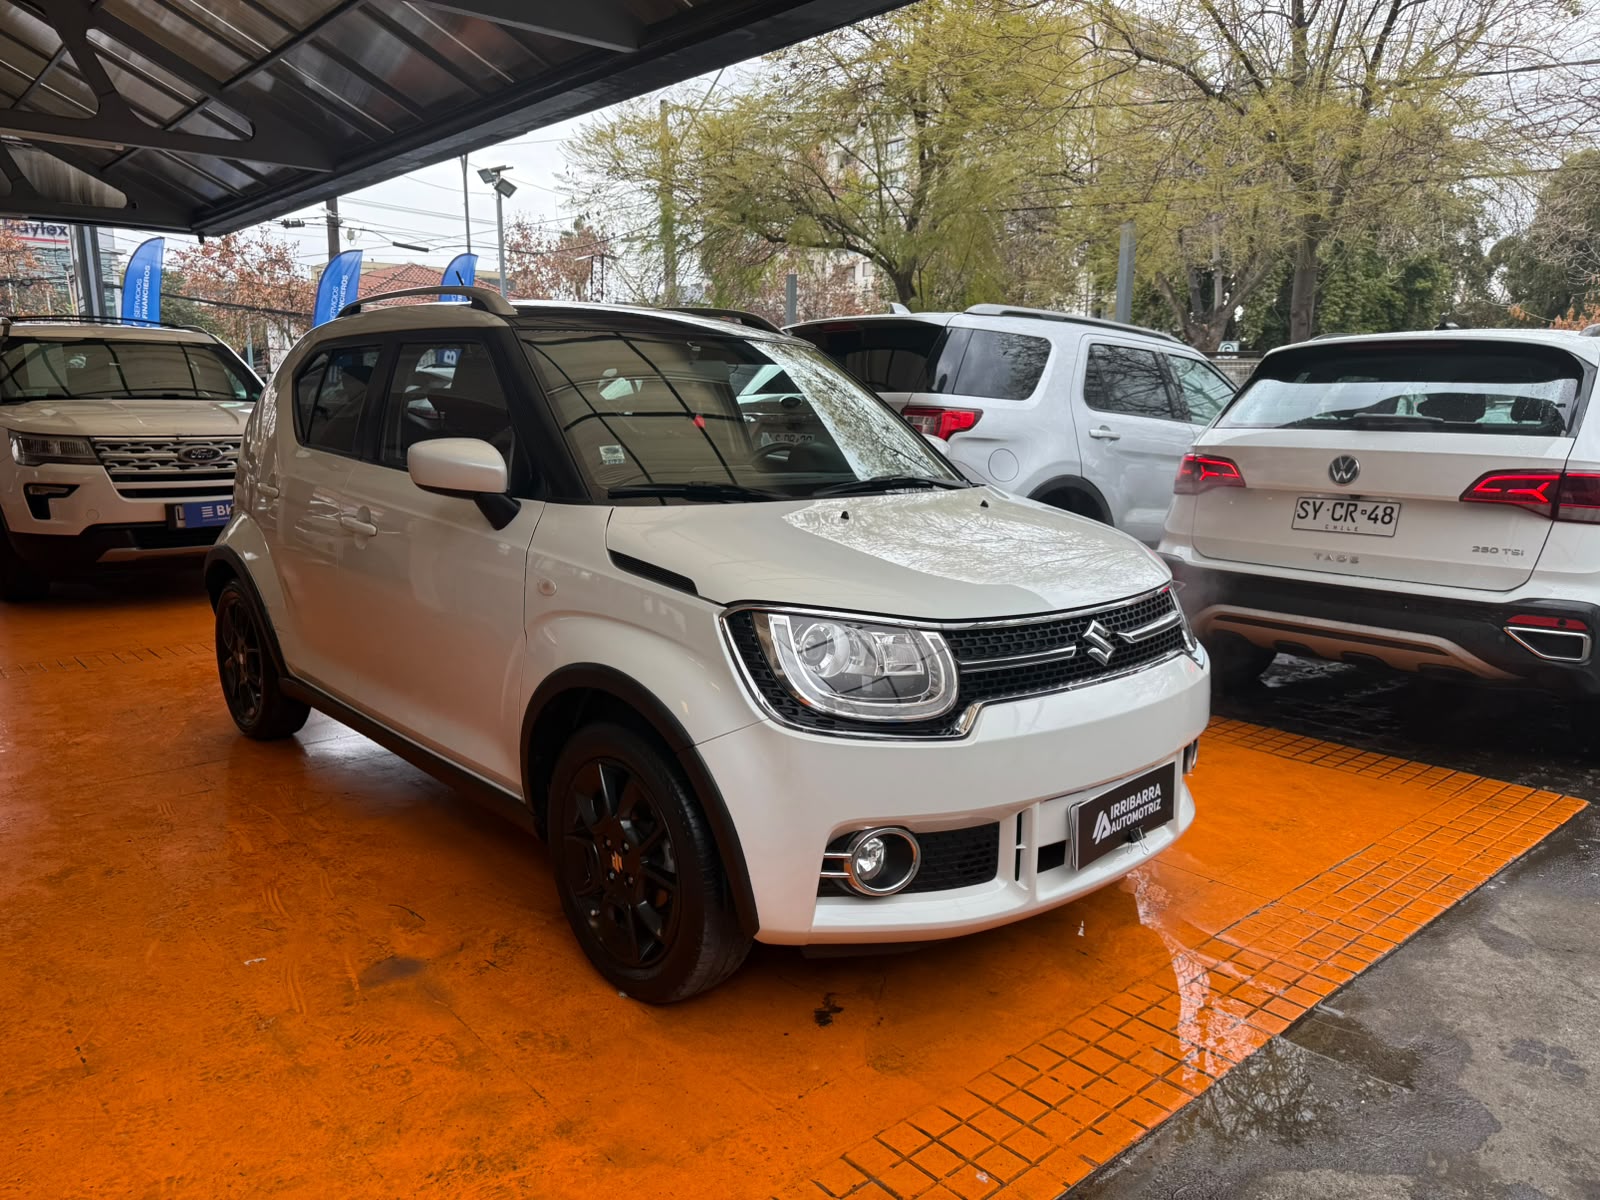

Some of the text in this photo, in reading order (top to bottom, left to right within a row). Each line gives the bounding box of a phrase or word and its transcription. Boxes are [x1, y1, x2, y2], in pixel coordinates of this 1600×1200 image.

[133, 278, 142, 318] SERVICIOS
[141, 265, 151, 320] FINANCIEROS
[329, 286, 339, 320] ERVICIOS
[1324, 524, 1359, 532] CHILE
[1472, 545, 1499, 554] 250
[1110, 783, 1162, 820] IRRIBARRA
[1110, 798, 1162, 834] AUTOMOTRIZ
